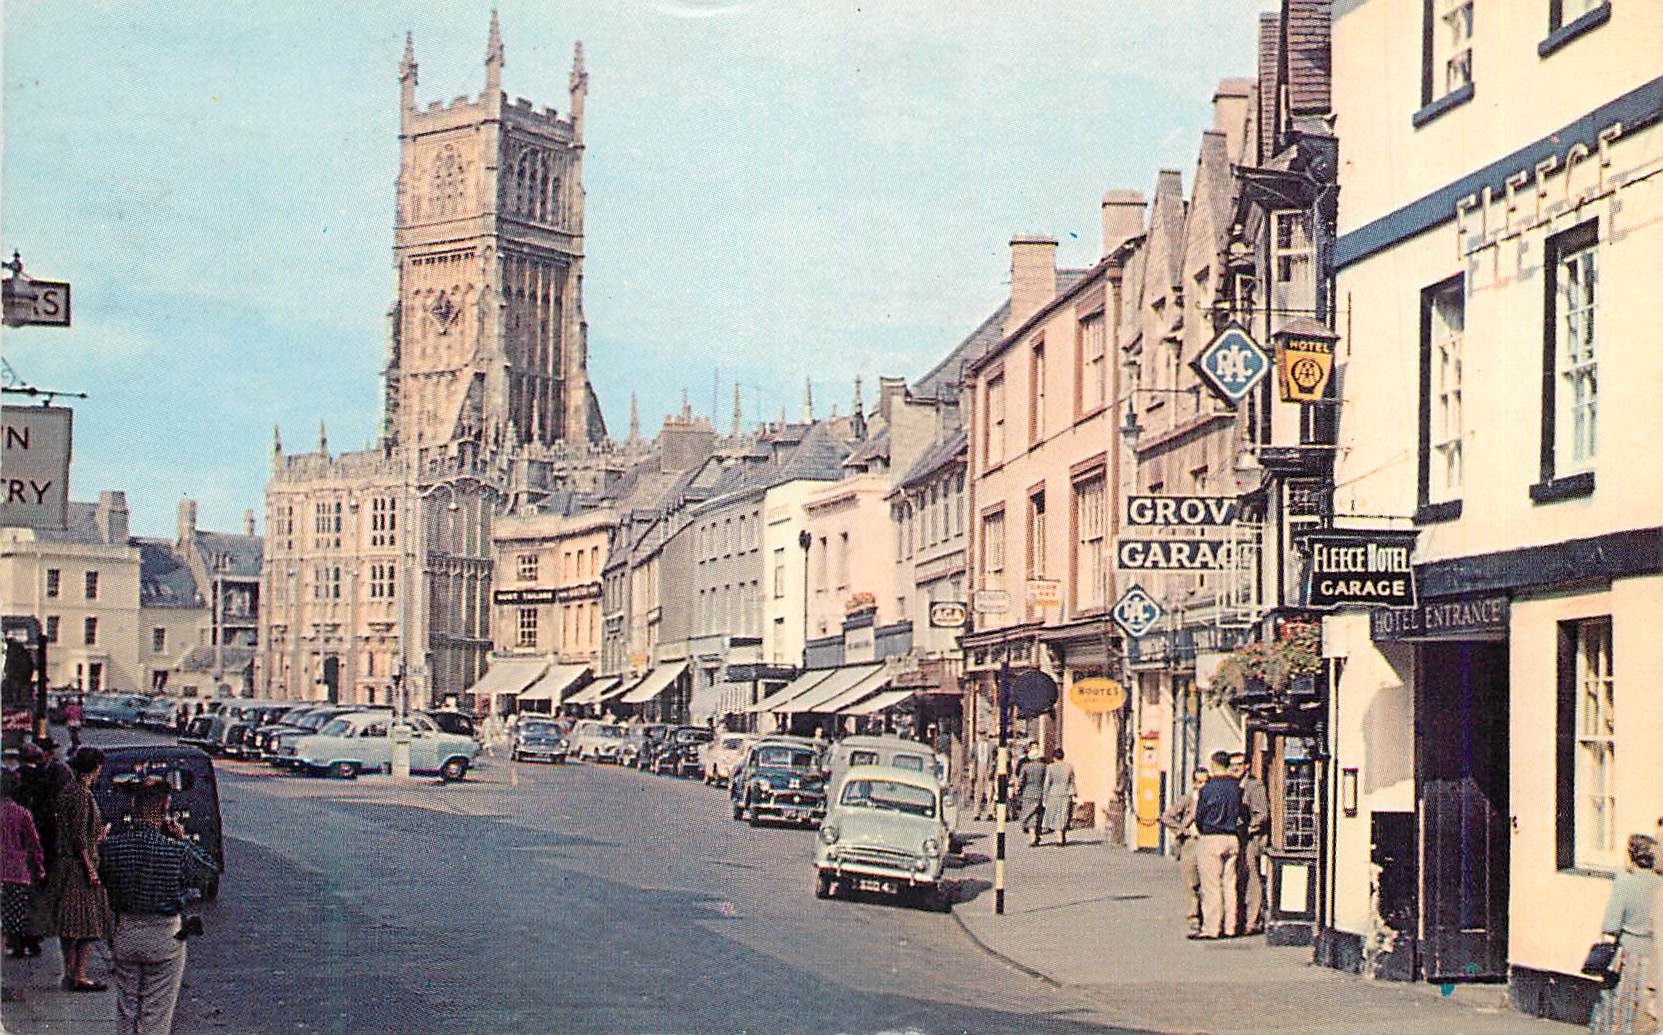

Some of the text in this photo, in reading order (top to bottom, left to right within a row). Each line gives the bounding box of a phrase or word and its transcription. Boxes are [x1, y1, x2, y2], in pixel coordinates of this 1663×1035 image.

[1456, 122, 1624, 260] FLEECE
[1289, 340, 1330, 353] HOTEL
[1215, 345, 1254, 383] RAC
[1, 425, 29, 450] N
[1, 478, 52, 504] RY
[1129, 498, 1238, 525] GROV
[1120, 542, 1251, 569] GARA
[1313, 543, 1411, 573] FLEECE HOTEL
[1320, 579, 1406, 597] GARAGE
[1374, 599, 1501, 633] HOTEL ENTRANCE
